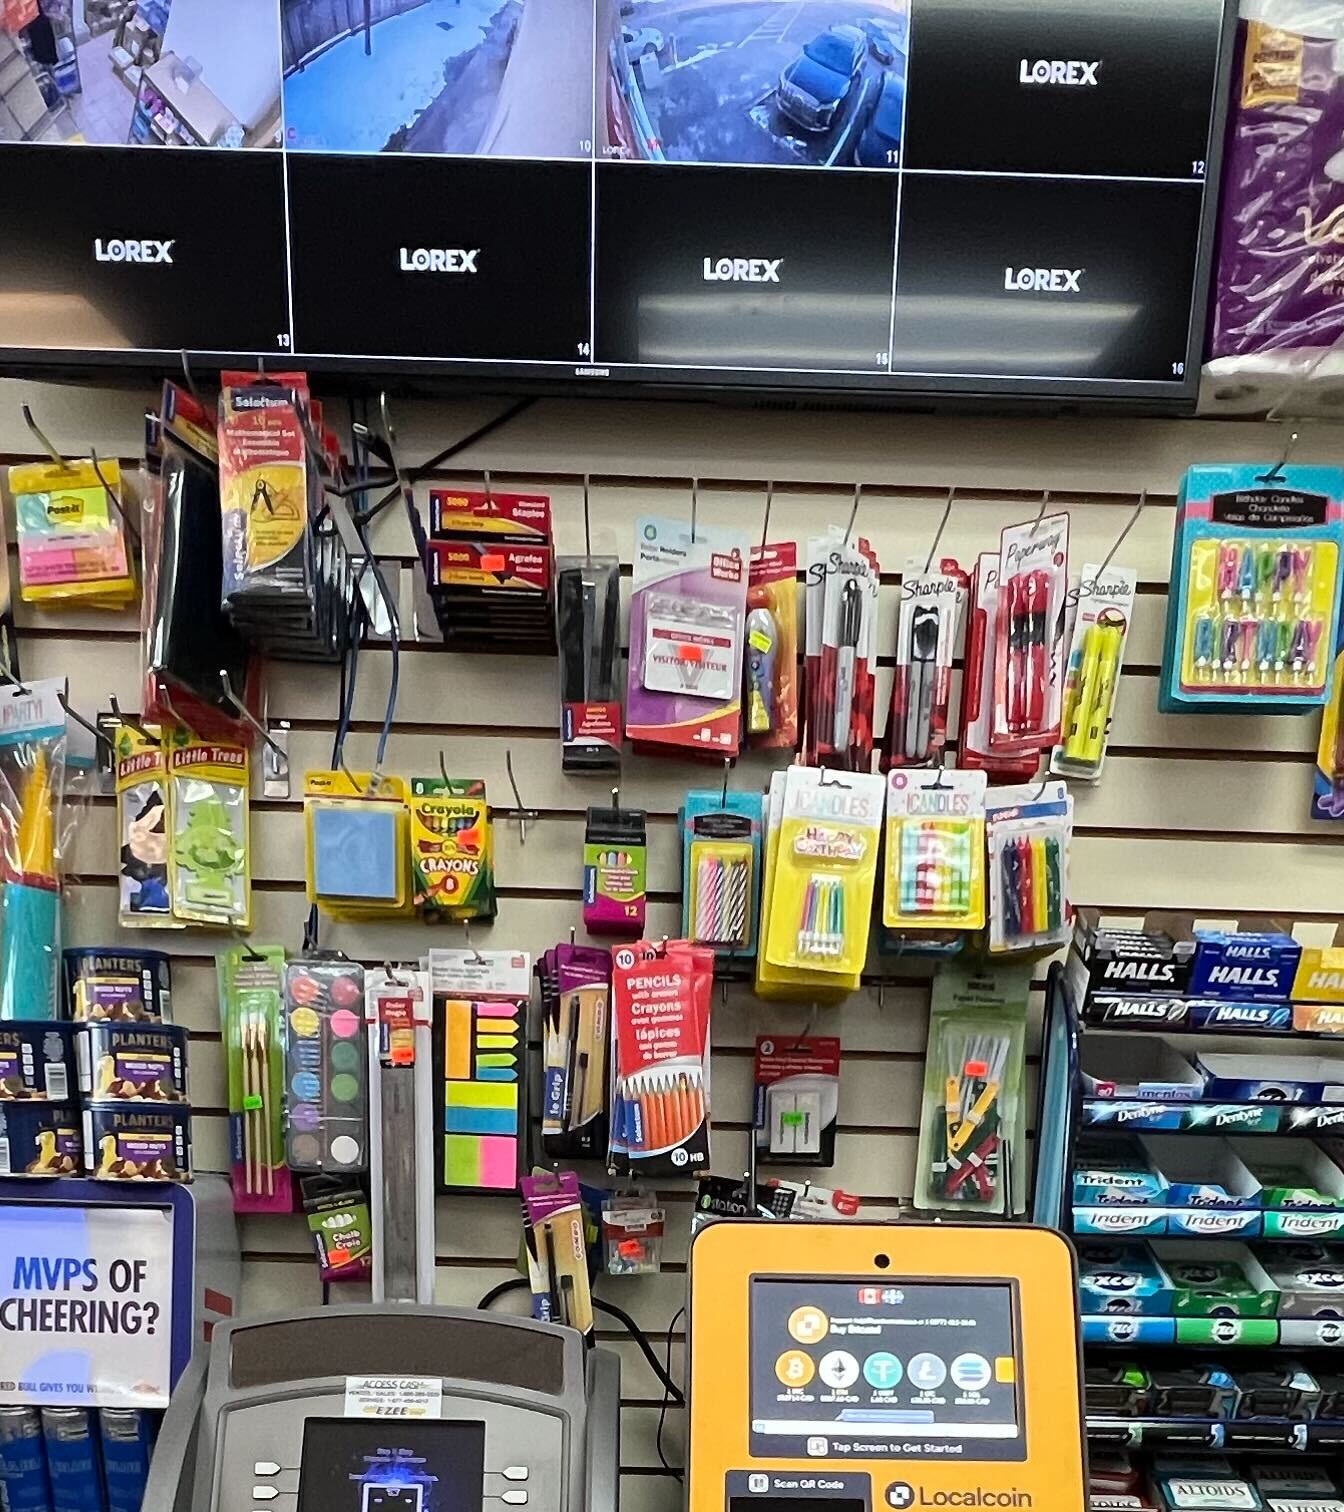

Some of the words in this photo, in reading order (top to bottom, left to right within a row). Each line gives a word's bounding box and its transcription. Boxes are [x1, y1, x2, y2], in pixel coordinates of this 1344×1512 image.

[579, 140, 592, 153] 10
[94, 239, 174, 264] LOREX
[400, 249, 478, 273] LOREX
[703, 259, 781, 283] LOREX
[1005, 268, 1082, 292] LOREX
[276, 334, 290, 347] 13
[577, 344, 590, 356] 14
[1171, 362, 1184, 375] 16
[902, 579, 956, 600] Sharpie
[1079, 575, 1133, 597] Sharpie
[174, 750, 207, 766] Little
[212, 748, 243, 765] Trees
[421, 803, 475, 817] Crayola
[419, 858, 479, 875] CRAYONS
[625, 905, 638, 917] 12
[619, 953, 632, 966] 10
[1104, 961, 1175, 983] HALLS
[1208, 966, 1278, 987] HALLS
[626, 973, 682, 990] PENCILS
[631, 1001, 682, 1017] Crayons
[111, 1032, 174, 1047] PLANTERS
[635, 1026, 681, 1042] lápices
[112, 1112, 174, 1127] PLANTERS
[673, 1150, 687, 1164] 10
[689, 1151, 704, 1164] HB
[13, 1256, 98, 1291] MVPS
[109, 1259, 147, 1293] OF
[363, 1380, 398, 1390] ACCESS
[376, 1407, 408, 1416] EZEE
[833, 1442, 851, 1454] Tap
[853, 1442, 888, 1453] Screen
[890, 1443, 901, 1452] to
[903, 1444, 927, 1453] Get
[928, 1444, 963, 1454] Started
[774, 1479, 799, 1489] Scan
[801, 1479, 816, 1489] QR
[818, 1480, 844, 1490] Code
[1176, 1483, 1247, 1497] ALTOIDS
[920, 1486, 1032, 1508] Localcoin
